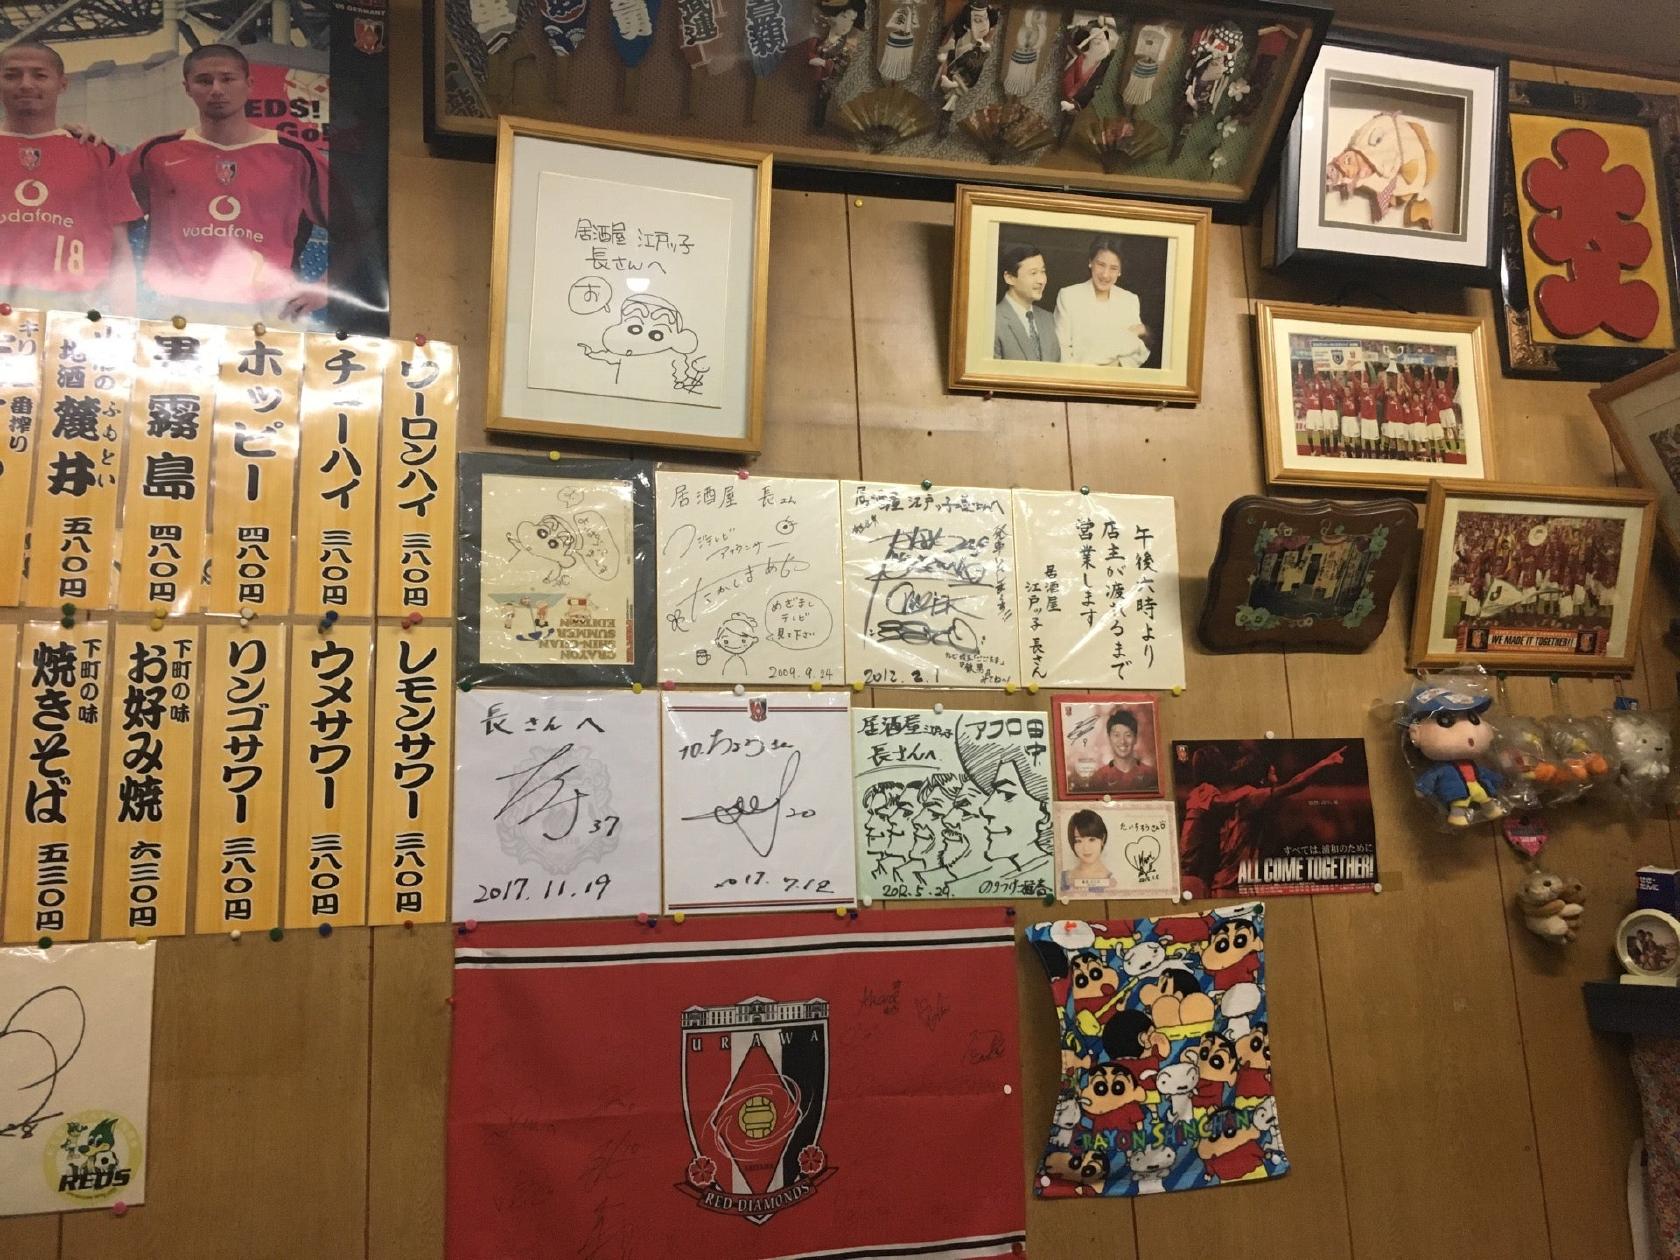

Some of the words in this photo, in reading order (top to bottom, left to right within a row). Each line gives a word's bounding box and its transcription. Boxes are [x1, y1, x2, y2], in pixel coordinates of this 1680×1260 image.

[182, 224, 264, 243] vodafone
[575, 218, 626, 246] 居酒屋
[54, 234, 85, 275] 18
[585, 246, 667, 274] 長さんへ
[143, 336, 201, 500] 黒霧島
[234, 340, 284, 501] ホッピー
[320, 349, 366, 509] チーハイ
[397, 360, 440, 517] ウーロンハイ
[98, 401, 121, 488] ふもとい
[671, 484, 738, 508] 居酒屋
[1044, 564, 1061, 612] 居酒屋
[1077, 518, 1097, 628] 営業します
[771, 596, 816, 612] めざまし
[1134, 524, 1158, 668] 午後六時より
[557, 628, 616, 638] SUMMER
[781, 612, 810, 622] テレビ
[1491, 635, 1503, 644] WE
[1504, 636, 1524, 645] MADE
[1526, 636, 1534, 645] IT
[78, 638, 102, 725] 下町の味
[170, 639, 193, 723] 下町の味
[25, 641, 77, 824] 焼きそば
[118, 641, 168, 823] お好み焼
[309, 640, 354, 809] ウメサワー
[394, 640, 438, 818] レモンサワー
[480, 702, 605, 736] 長さんへ
[588, 816, 620, 837] 37
[1238, 860, 1261, 884] ALL
[1264, 857, 1303, 883] COME
[1305, 854, 1374, 880] TOGETHER!
[692, 1029, 818, 1050] URAWA
[58, 1168, 131, 1192] REDS
[705, 1191, 732, 1210] RED
[738, 1184, 811, 1212] DIAMONDS
